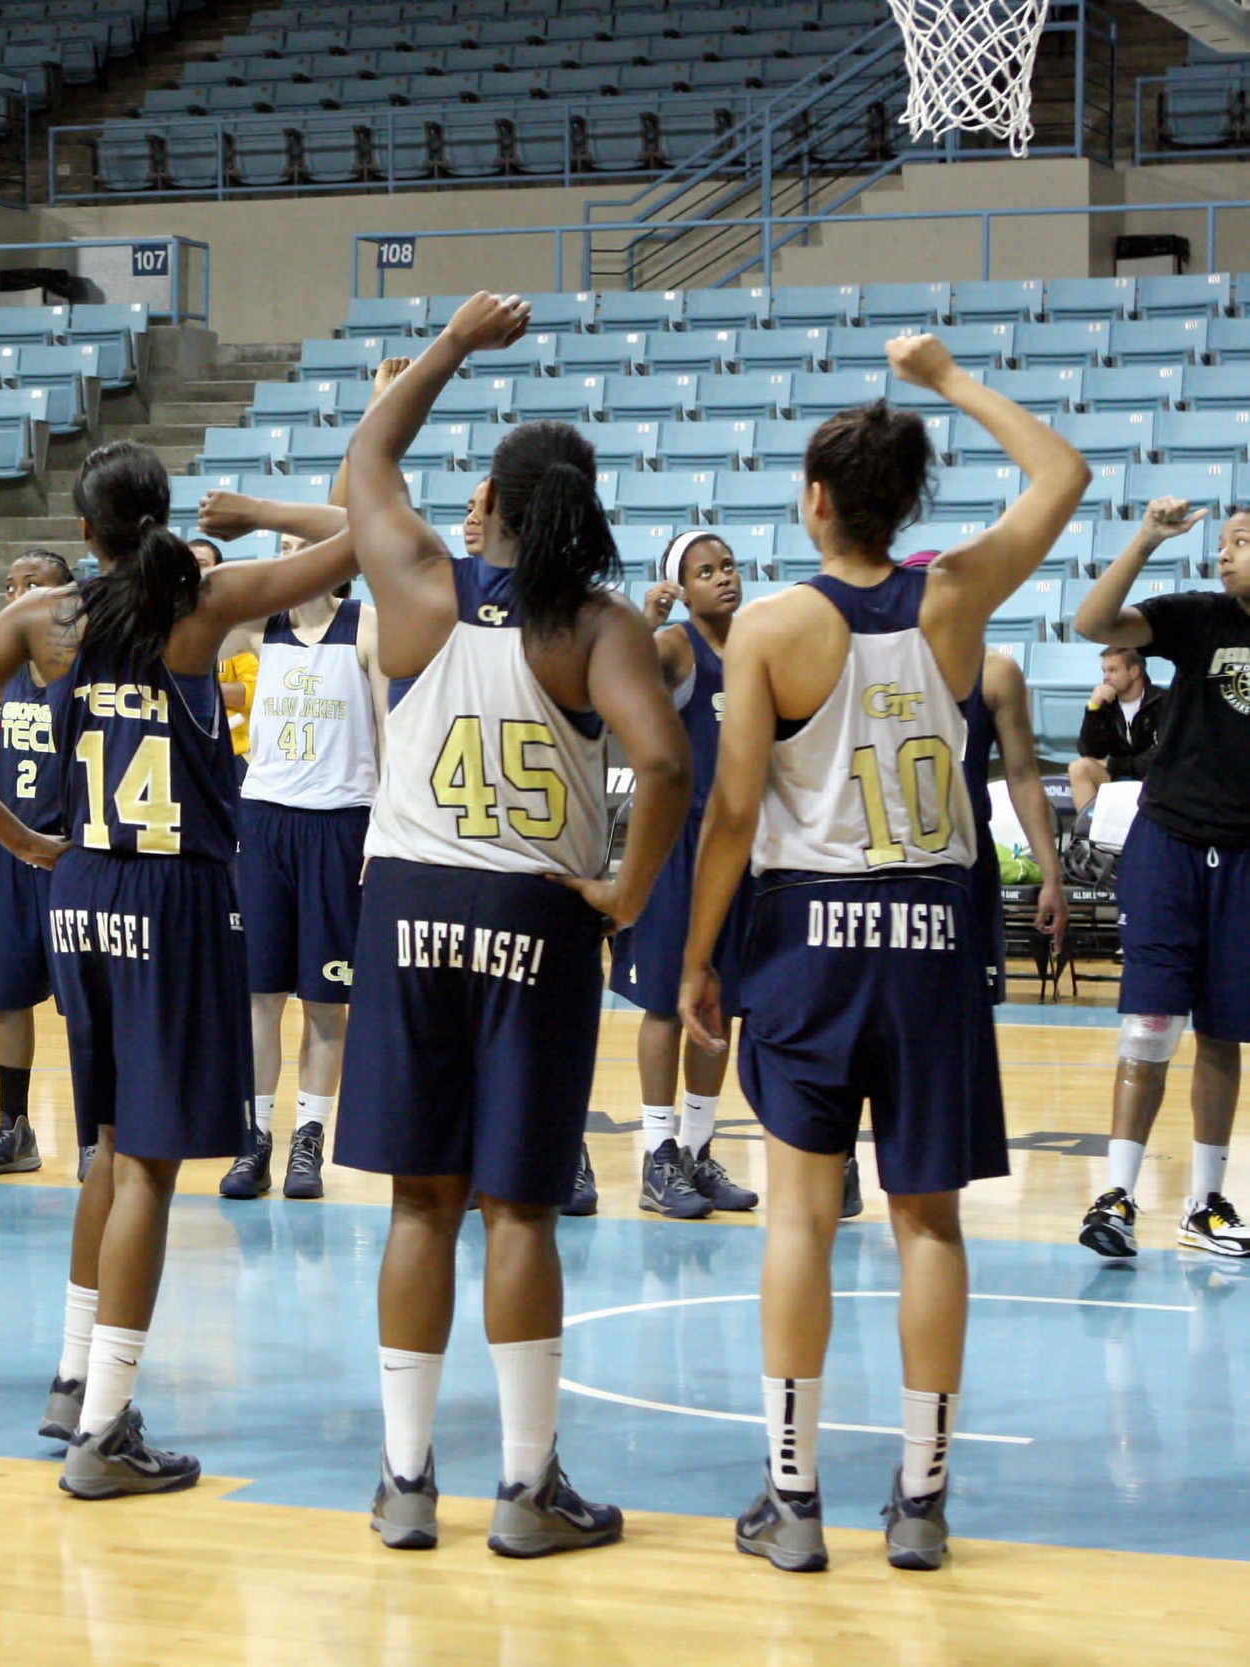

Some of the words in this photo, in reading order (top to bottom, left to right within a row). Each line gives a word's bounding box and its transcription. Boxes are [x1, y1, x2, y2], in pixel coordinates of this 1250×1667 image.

[134, 251, 166, 270] 107
[380, 243, 412, 263] 108
[478, 604, 508, 626] GT
[284, 667, 323, 695] GT
[74, 683, 168, 724] TECH
[263, 698, 299, 718] YELLOW
[300, 698, 347, 720] JACKETS
[863, 681, 923, 722] GT
[277, 722, 316, 761] 41
[16, 760, 37, 798] 2
[76, 730, 181, 855] 14
[430, 715, 567, 840] 45
[850, 735, 953, 868] 10
